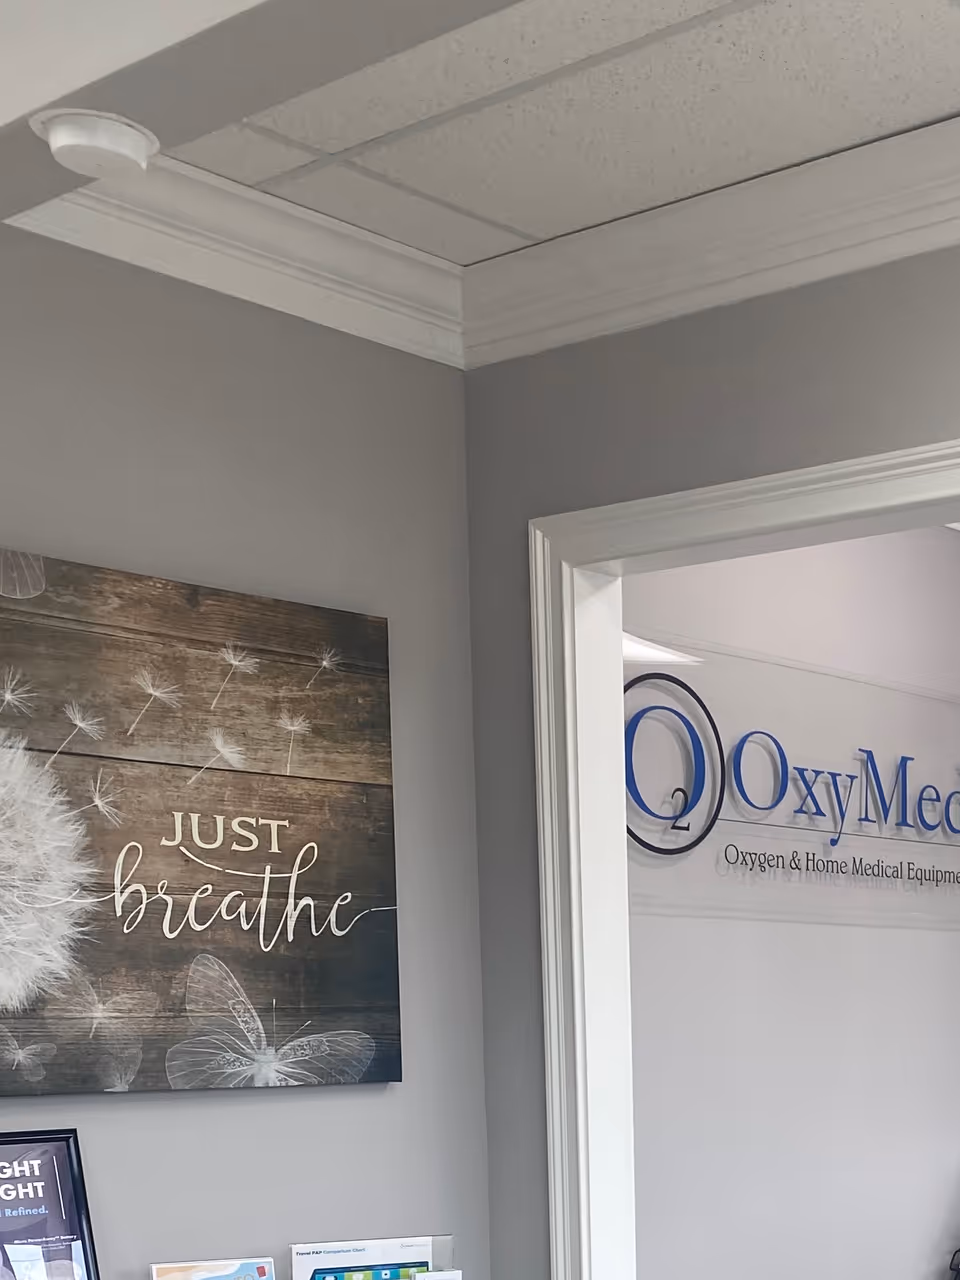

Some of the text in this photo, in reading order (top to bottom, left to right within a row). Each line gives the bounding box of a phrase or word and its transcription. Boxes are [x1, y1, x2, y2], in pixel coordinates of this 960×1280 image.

[160, 811, 289, 853] JUST
[724, 844, 785, 873] Oxygen
[789, 850, 801, 871] &
[805, 852, 848, 874] Home
[852, 857, 903, 880] Medical
[114, 842, 369, 952] breathe
[5, 1205, 49, 1217] Refined.
